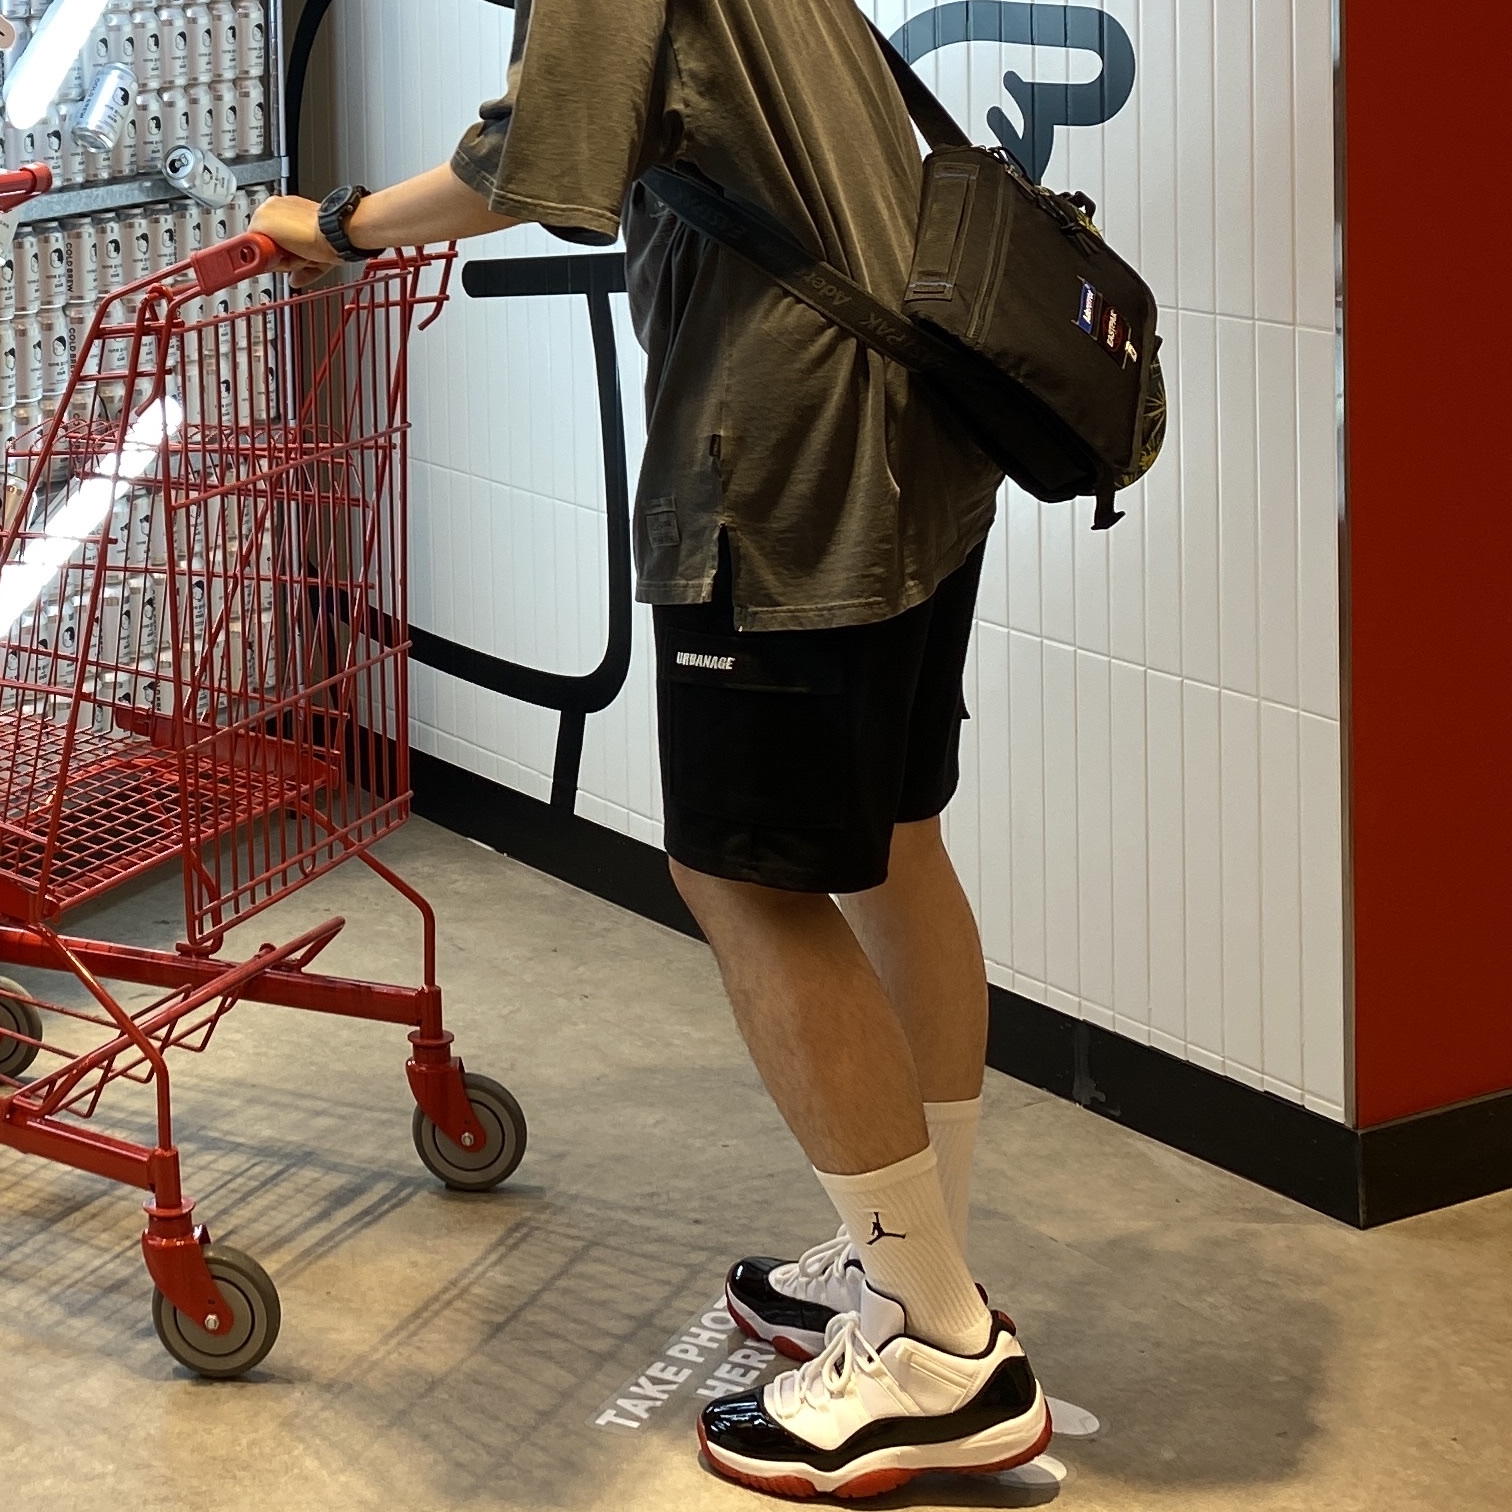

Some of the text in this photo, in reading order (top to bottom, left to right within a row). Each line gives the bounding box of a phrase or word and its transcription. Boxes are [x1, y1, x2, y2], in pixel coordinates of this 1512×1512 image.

[676, 652, 735, 669] URBANAGE
[595, 1296, 738, 1428] TAKE PHO
